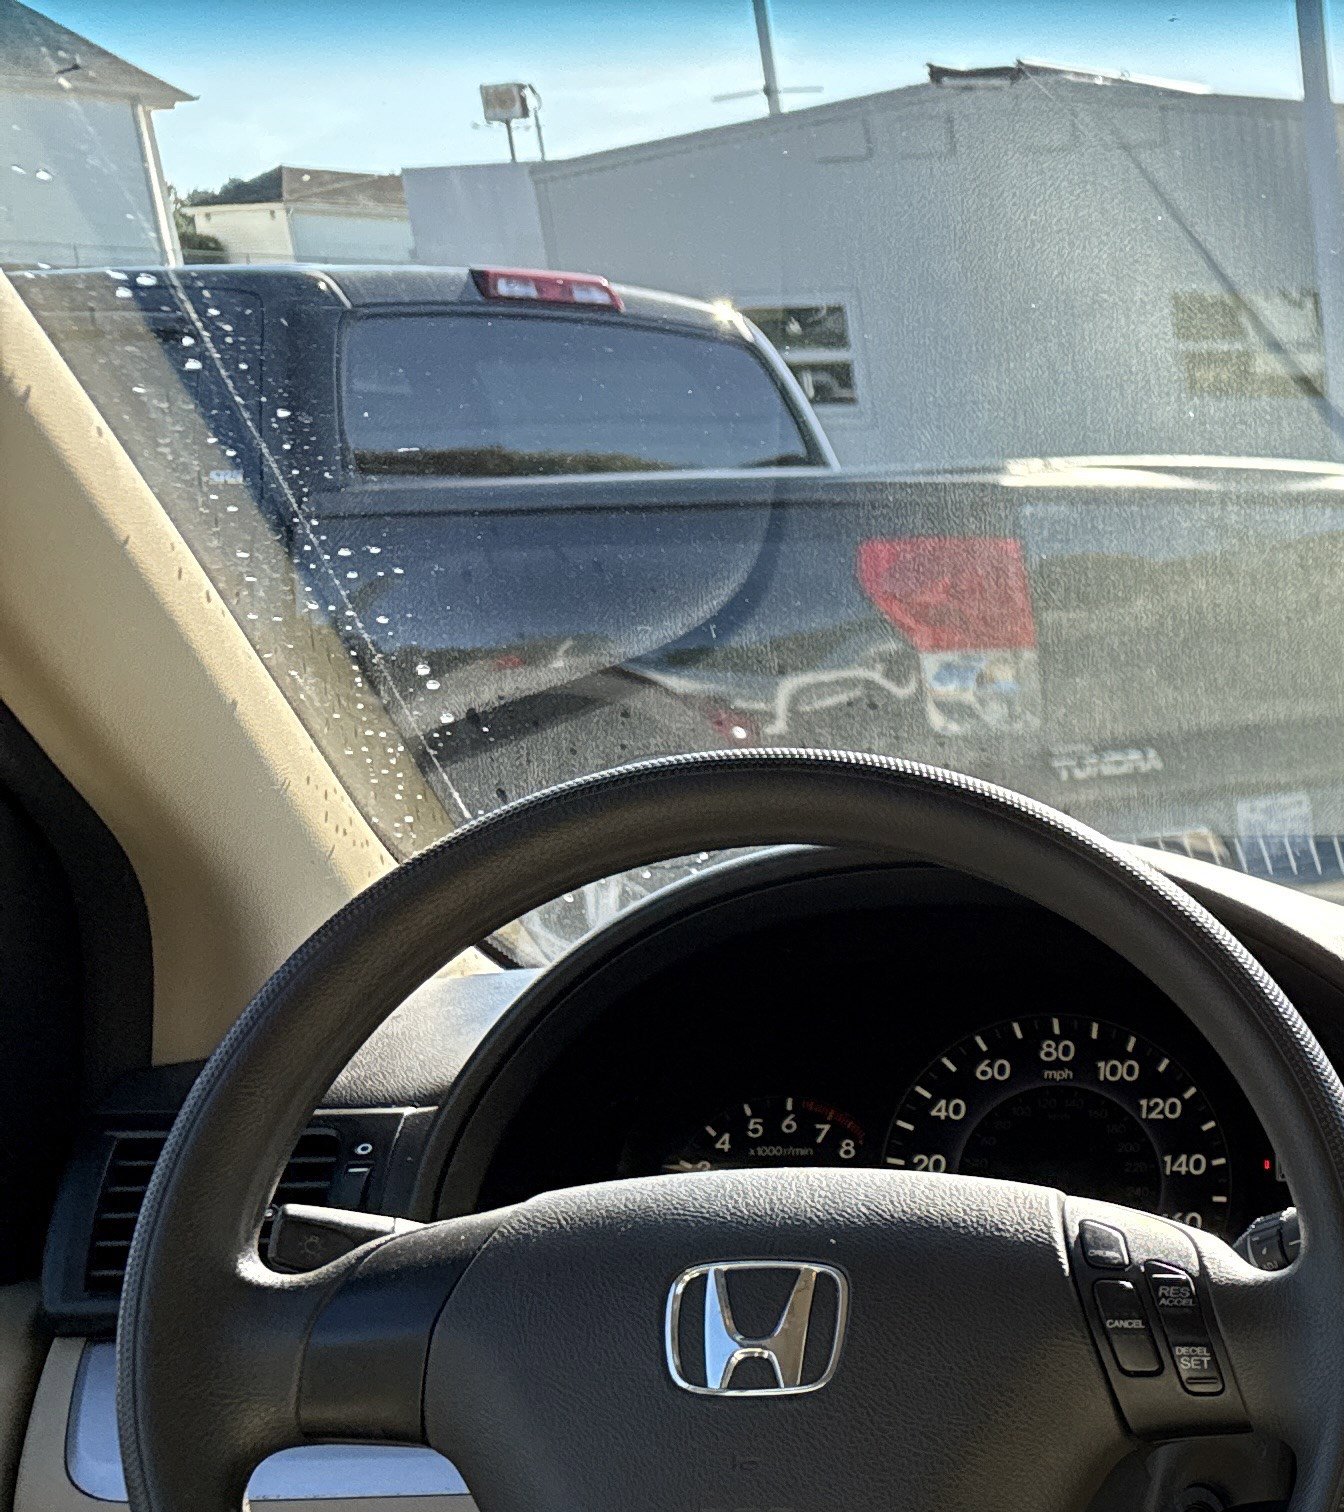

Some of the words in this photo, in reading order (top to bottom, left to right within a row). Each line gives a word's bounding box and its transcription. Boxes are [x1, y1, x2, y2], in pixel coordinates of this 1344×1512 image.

[1039, 1040, 1075, 1061] 80
[975, 1059, 1011, 1080] 60
[1043, 1068, 1073, 1081] mph
[1097, 1059, 1140, 1081] 100
[930, 1099, 966, 1120] 40
[1140, 1098, 1182, 1119] 120
[747, 1118, 764, 1138] 5
[781, 1114, 797, 1133] 6
[814, 1123, 832, 1143] 7
[714, 1132, 731, 1152] 4
[838, 1138, 856, 1159] 8
[912, 1154, 946, 1173] 20
[1163, 1154, 1207, 1176] 140
[1158, 1285, 1191, 1298] RES
[1158, 1298, 1195, 1307] ACCEL
[1106, 1319, 1146, 1329] CANCEL
[1175, 1346, 1211, 1356] DECEL
[1179, 1356, 1212, 1370] SET
